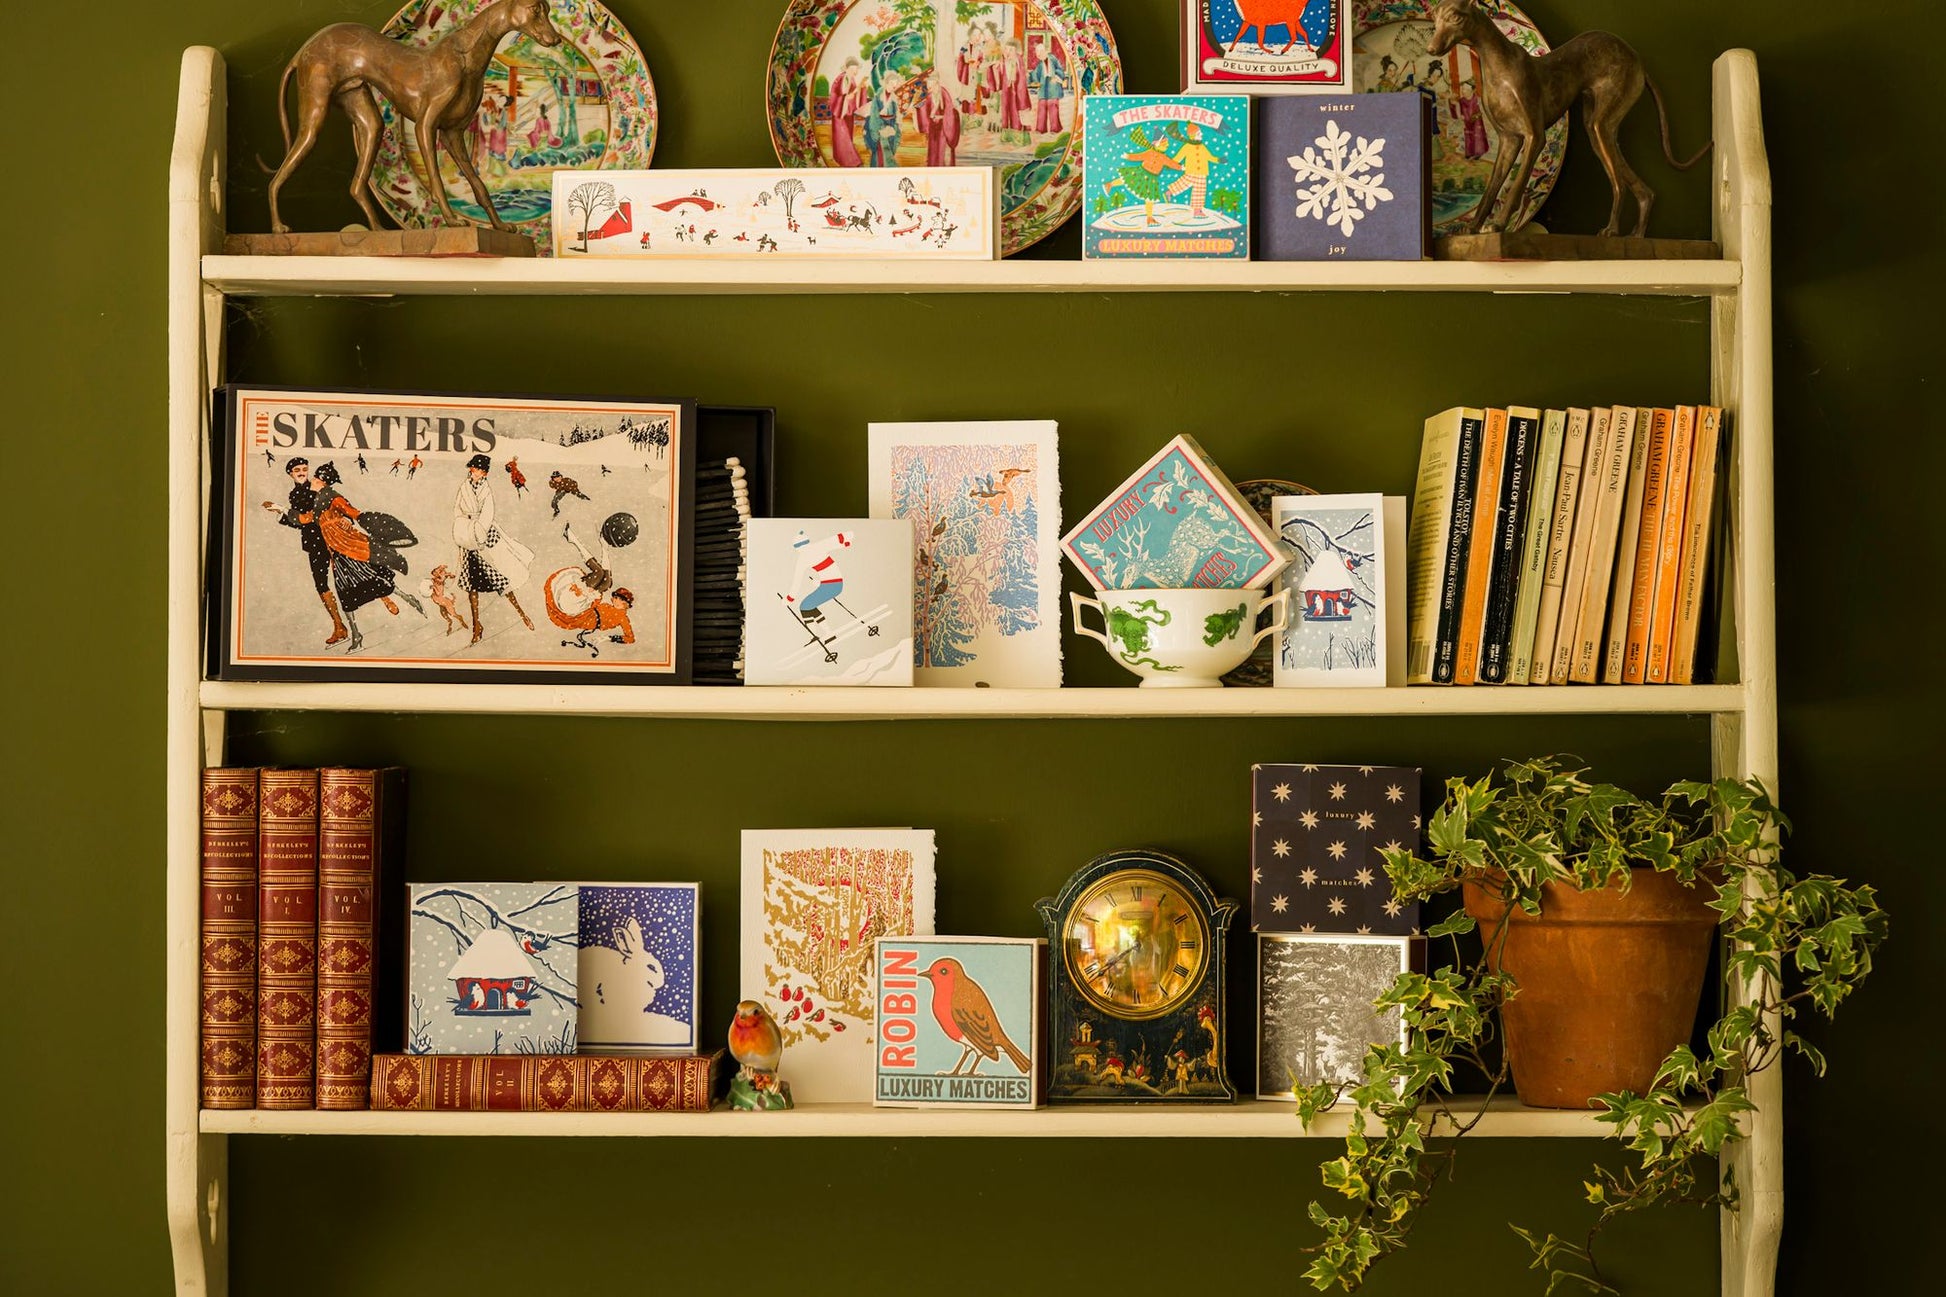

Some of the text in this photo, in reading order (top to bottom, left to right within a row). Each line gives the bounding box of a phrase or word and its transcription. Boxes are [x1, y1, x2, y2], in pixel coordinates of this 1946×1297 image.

[1202, 1, 1210, 23] MAD
[1222, 60, 1319, 73] DELUXE QUALITY
[1119, 105, 1218, 125] THE SKATERS
[1319, 103, 1355, 112] winter
[1102, 239, 1234, 252] LUXURY MATCHES
[1328, 244, 1347, 256] joy
[256, 411, 497, 453] THE SKATERS
[1491, 414, 1502, 442] Evelyn
[1516, 420, 1528, 456] DICKENS
[1635, 410, 1650, 471] Graham Greene
[1652, 412, 1666, 462] GRAHAM
[1677, 414, 1688, 445] Graham
[1487, 443, 1499, 467] Waugh
[1591, 417, 1608, 477] Graham Greene
[1608, 411, 1628, 494] GRAHAM GREENE
[1675, 446, 1685, 473] Greene
[1512, 471, 1521, 490] TALE
[1646, 463, 1661, 511] GREENE
[1510, 491, 1519, 502] OF
[1092, 489, 1147, 543] LUXURY
[1445, 422, 1472, 610] THE DEATH OF IVAN ILYICH AND OTHER STORIES
[1461, 498, 1472, 536] TOLSTOY
[1507, 503, 1517, 523] TWO
[1537, 518, 1545, 529] The
[1549, 471, 1574, 580] Jean-Paul Sartre Nausea
[1643, 513, 1656, 536] THE
[1505, 524, 1515, 551] CITIES
[1535, 530, 1543, 548] Great
[1192, 552, 1238, 589] TCHES
[1531, 549, 1541, 572] Gatsby
[1638, 539, 1652, 583] HUMAN
[1633, 585, 1647, 627] FACTOR
[1325, 811, 1355, 819] luxury
[881, 950, 918, 1068] ROBIN
[880, 1077, 1028, 1100] LUXURY MATCHES
